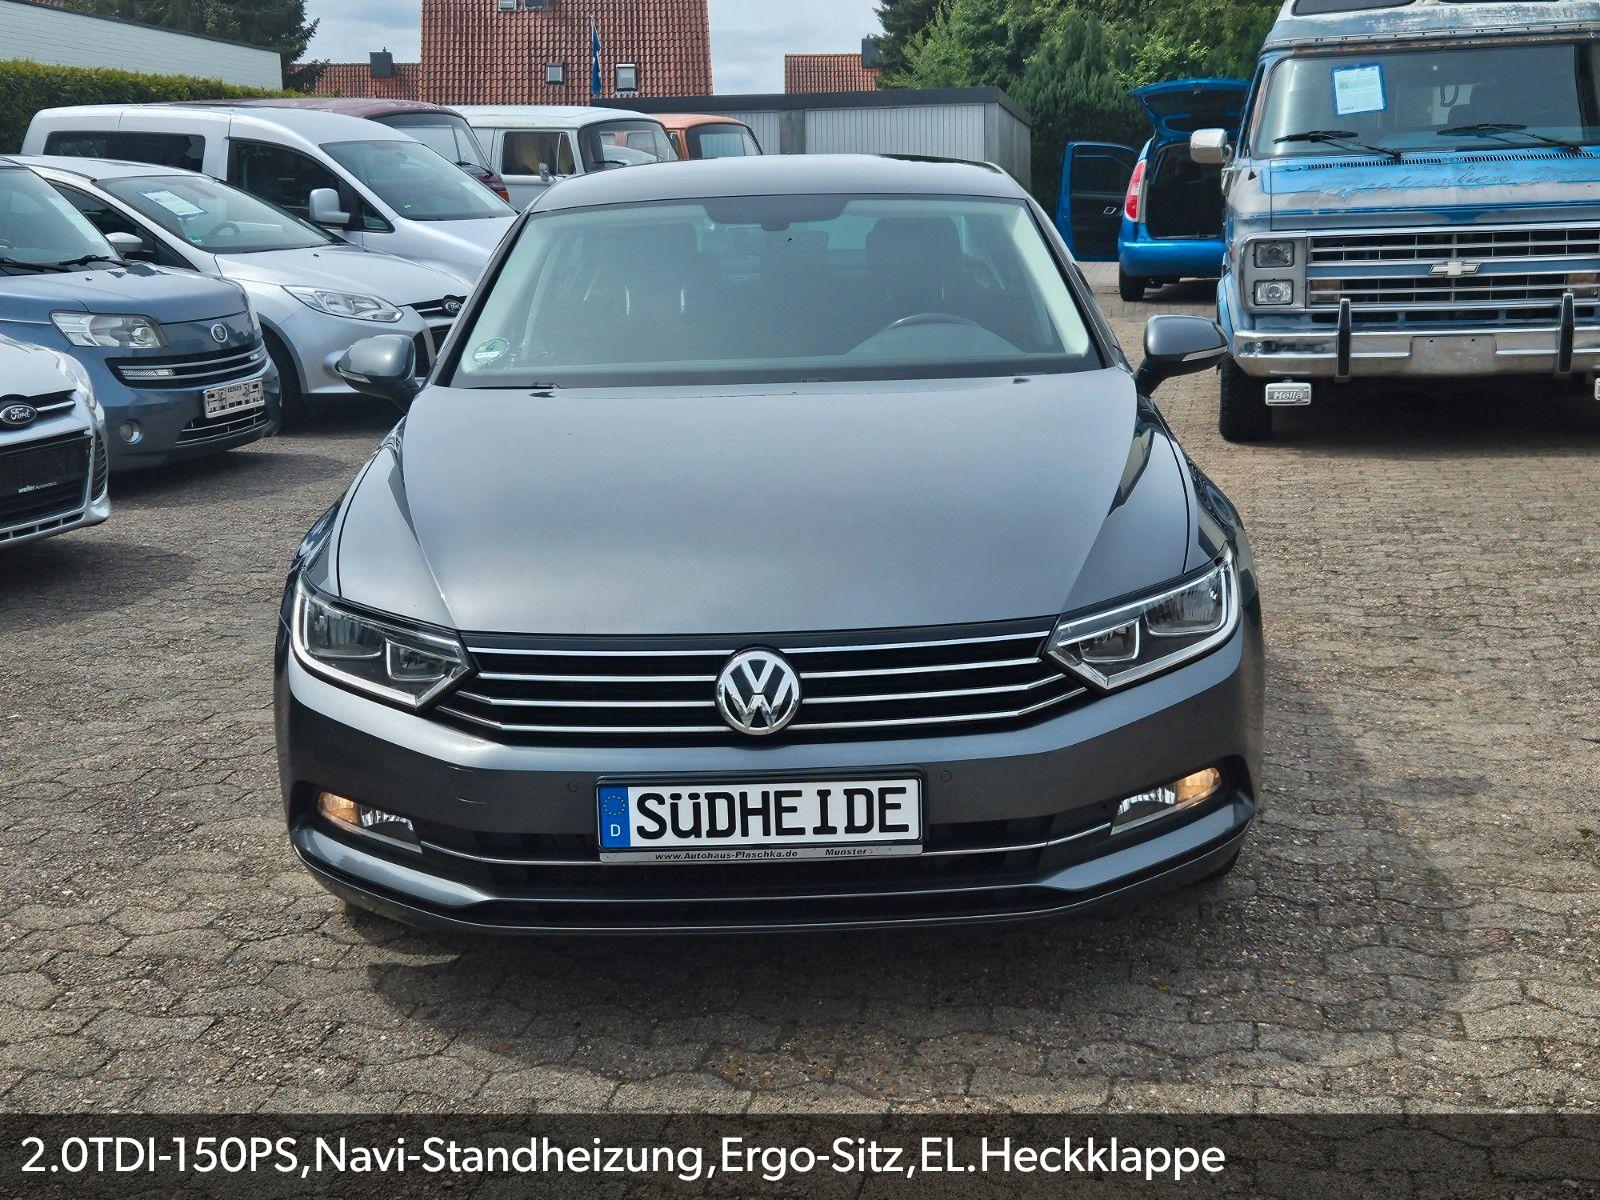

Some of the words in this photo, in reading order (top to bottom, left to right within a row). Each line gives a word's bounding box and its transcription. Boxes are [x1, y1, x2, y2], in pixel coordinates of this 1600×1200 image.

[10, 407, 30, 420] Ford
[610, 824, 621, 837] D
[655, 850, 798, 861] www.Autohaus-Plaschka.de
